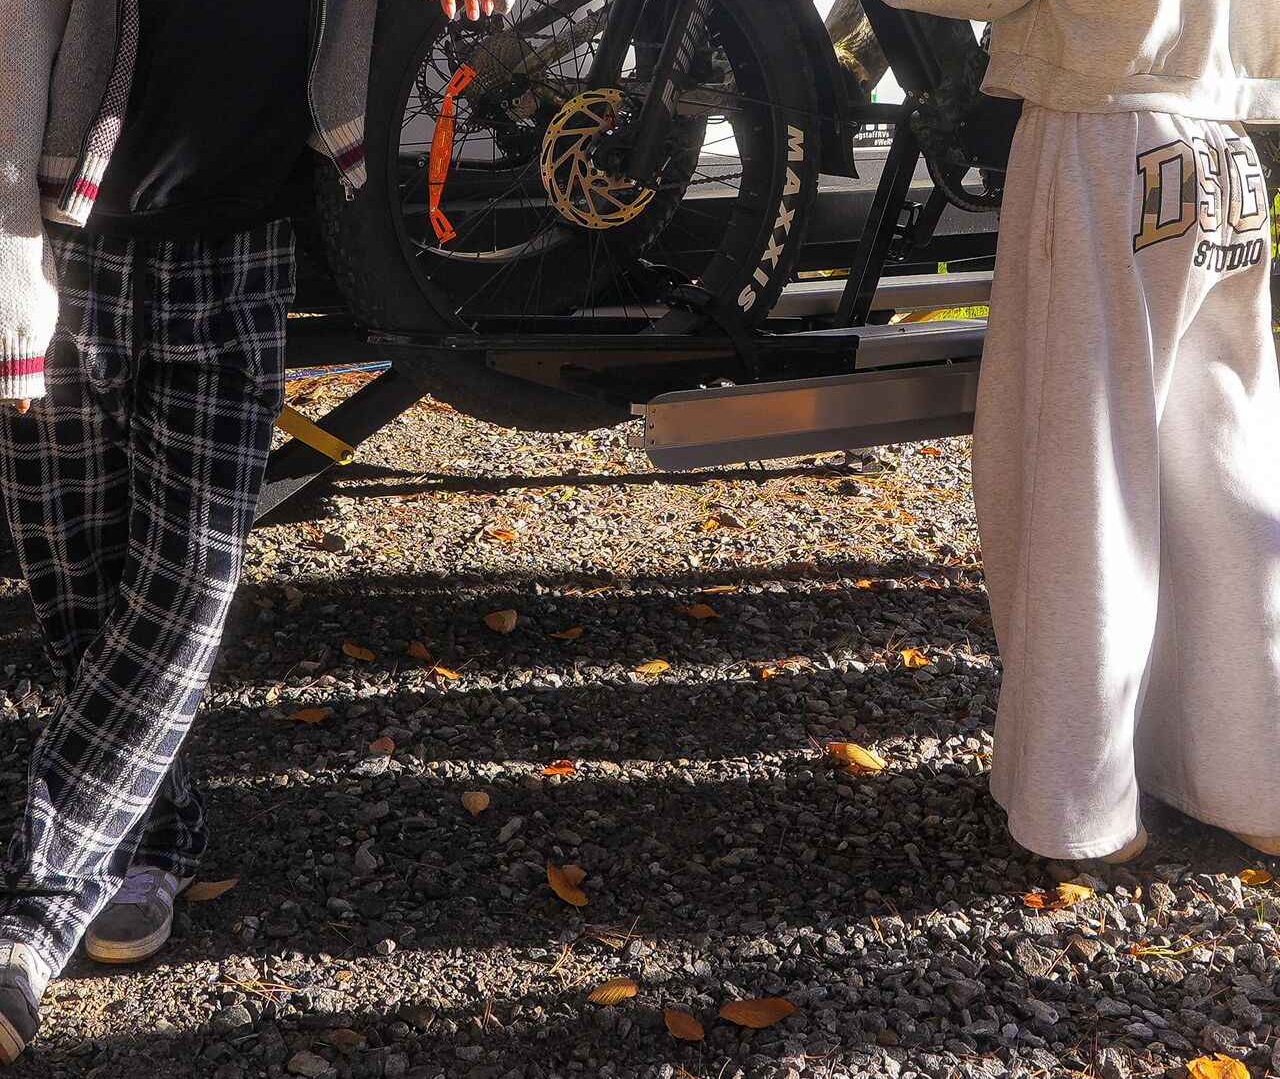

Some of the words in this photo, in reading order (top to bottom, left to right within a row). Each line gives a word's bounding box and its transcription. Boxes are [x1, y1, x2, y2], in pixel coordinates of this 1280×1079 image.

[854, 130, 890, 141] agstaffRVs
[737, 124, 805, 313] MAXXIS
[1132, 136, 1268, 254] DSG
[1193, 237, 1264, 273] STUDIO
